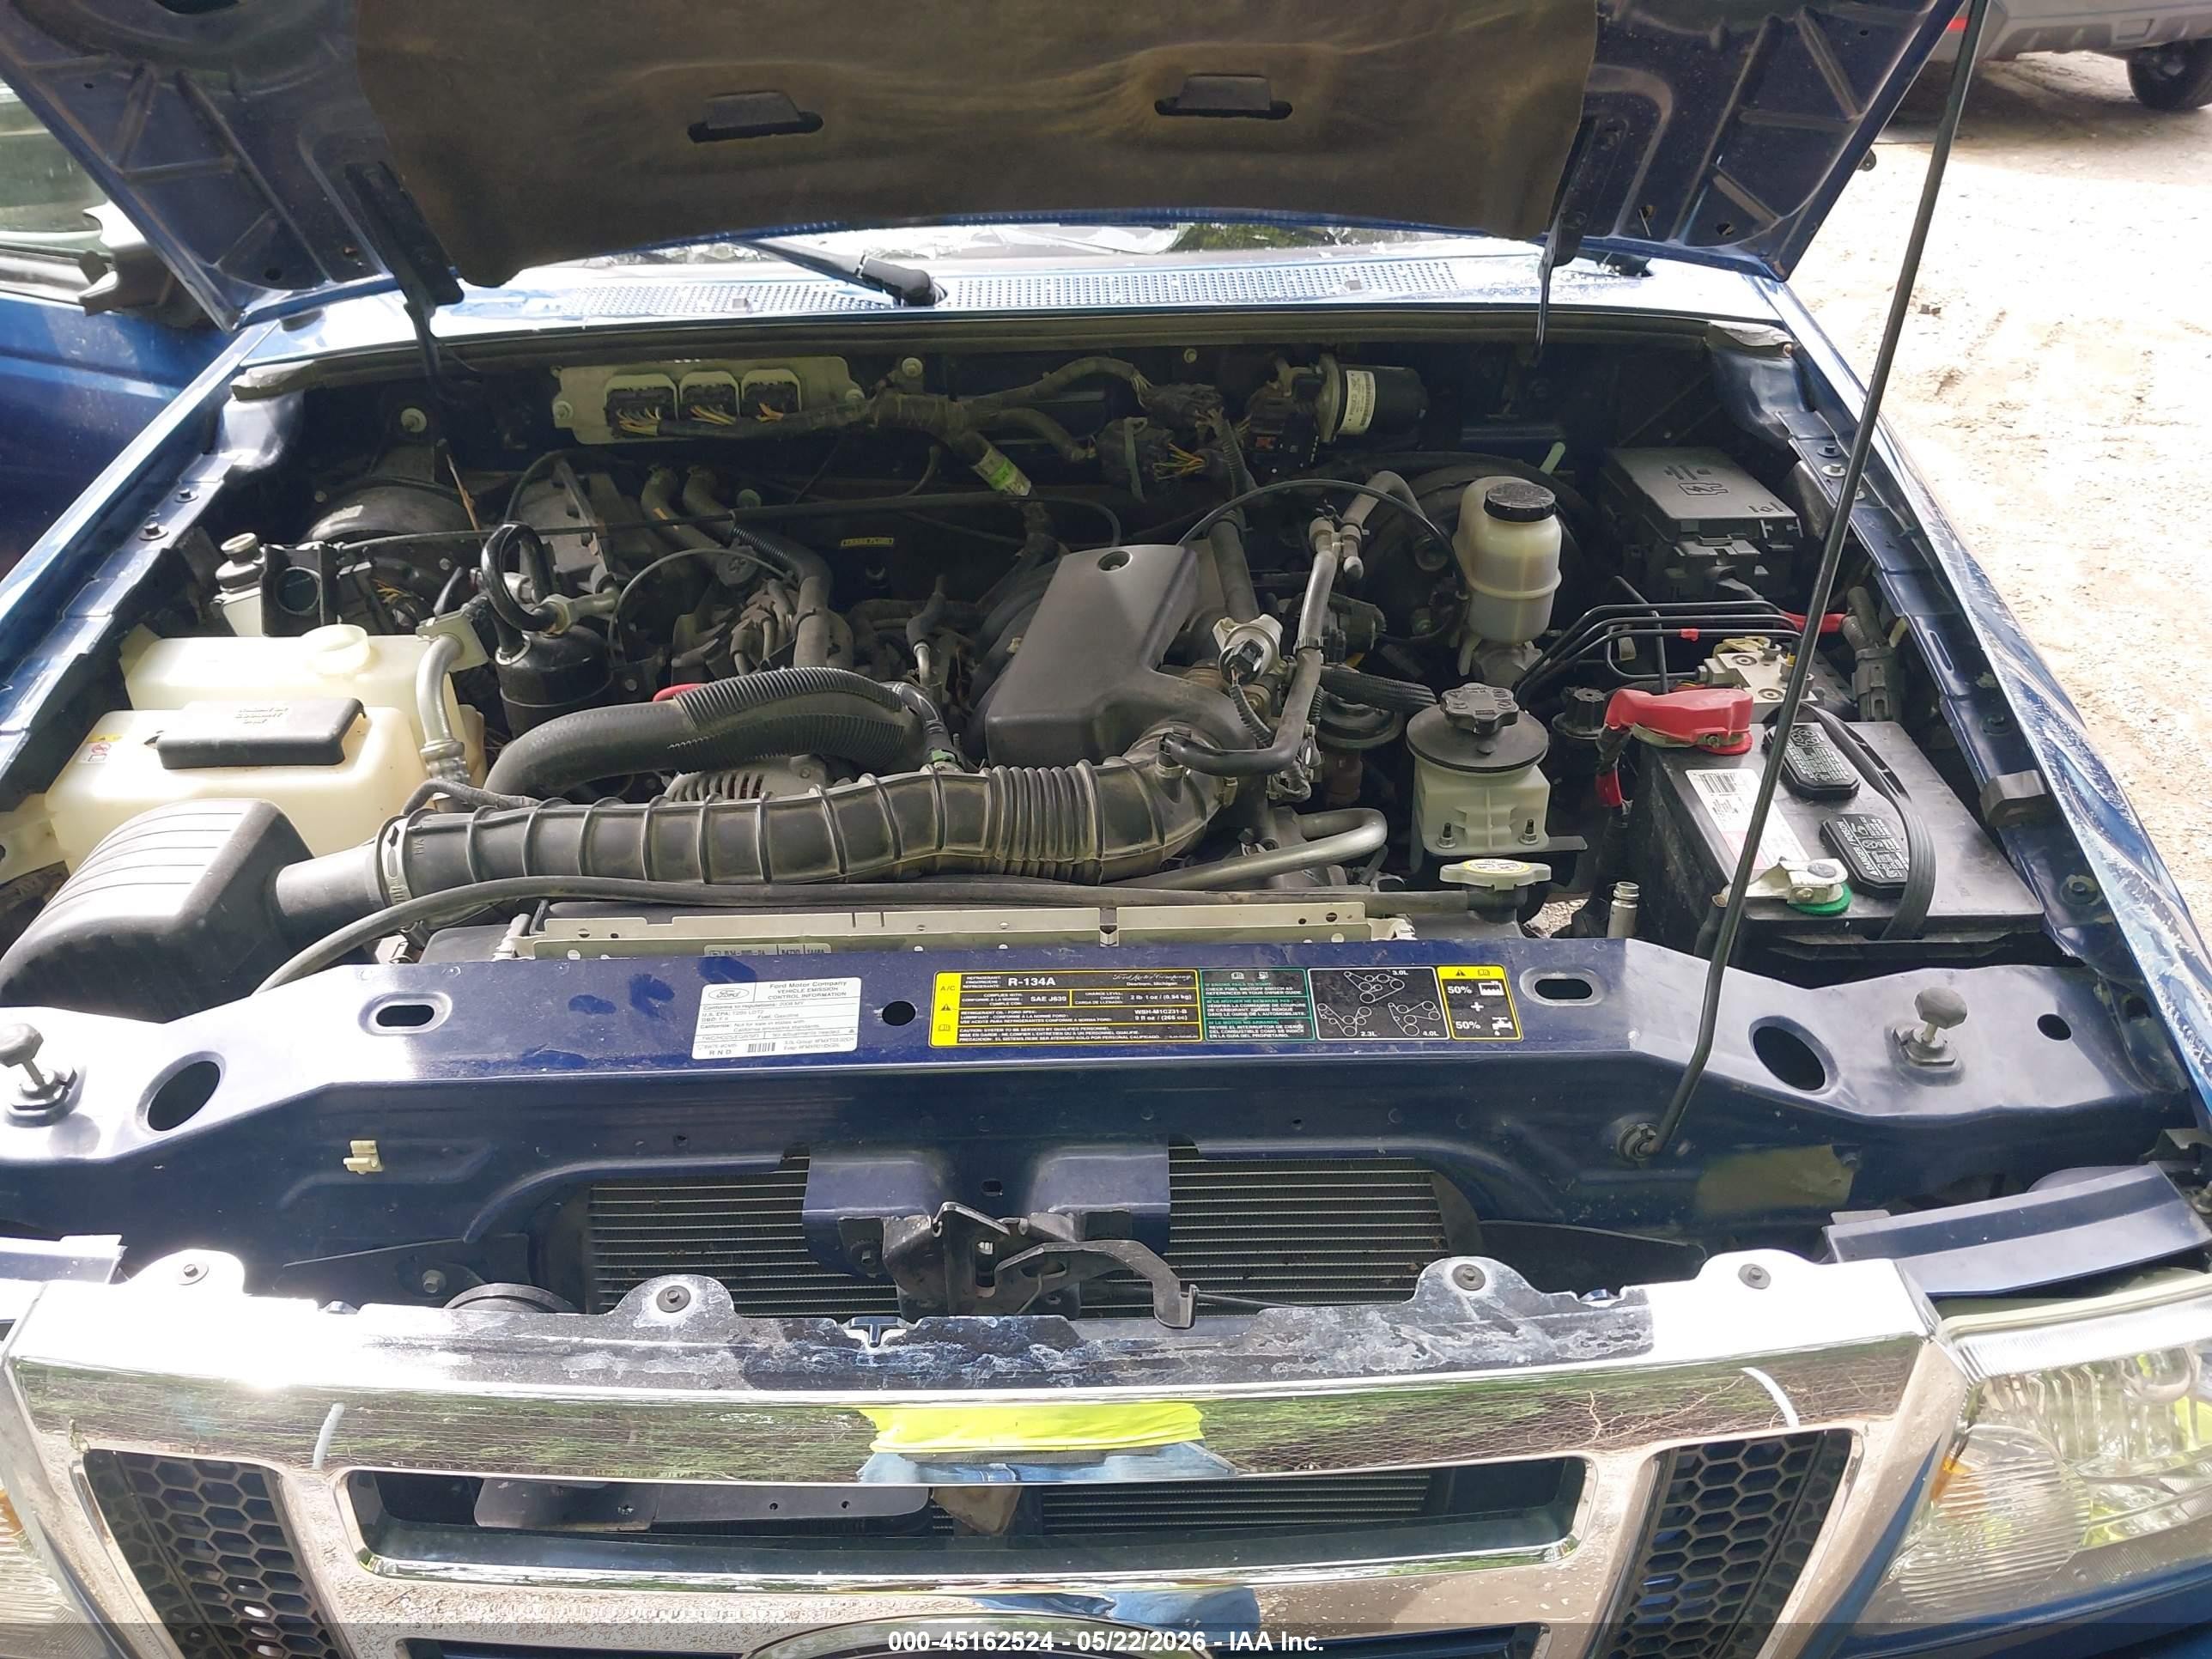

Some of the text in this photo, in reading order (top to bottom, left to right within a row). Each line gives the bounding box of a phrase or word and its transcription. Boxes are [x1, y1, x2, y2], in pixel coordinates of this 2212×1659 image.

[1836, 821, 1855, 842] POISON
[1007, 977, 1056, 987] R-134A
[1447, 986, 1473, 994] 50%
[1455, 1021, 1481, 1030] 50%
